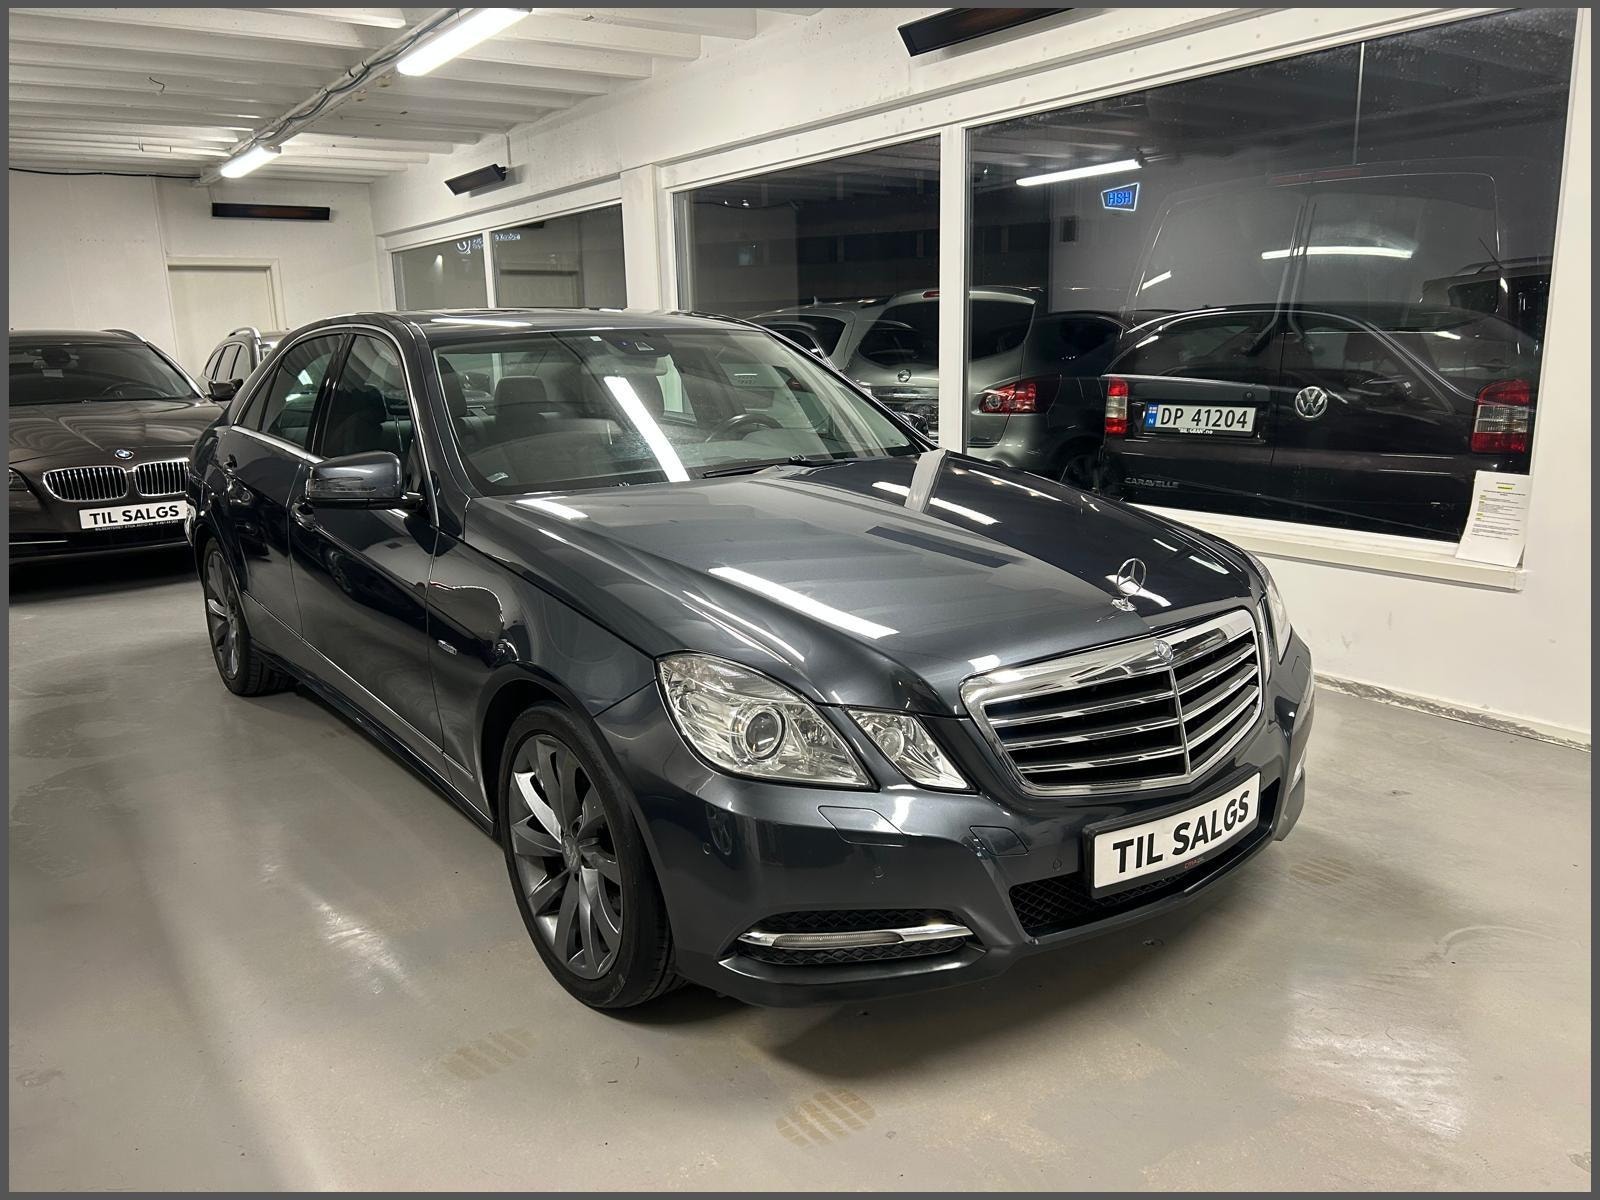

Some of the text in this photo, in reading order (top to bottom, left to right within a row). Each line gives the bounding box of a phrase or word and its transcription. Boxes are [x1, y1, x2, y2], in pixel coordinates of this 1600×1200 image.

[1160, 407, 1248, 429] DP 41204
[1124, 477, 1179, 489] CARAVELLE
[89, 505, 180, 525] TIL SALGS
[1112, 790, 1250, 874] TIL SALGS
